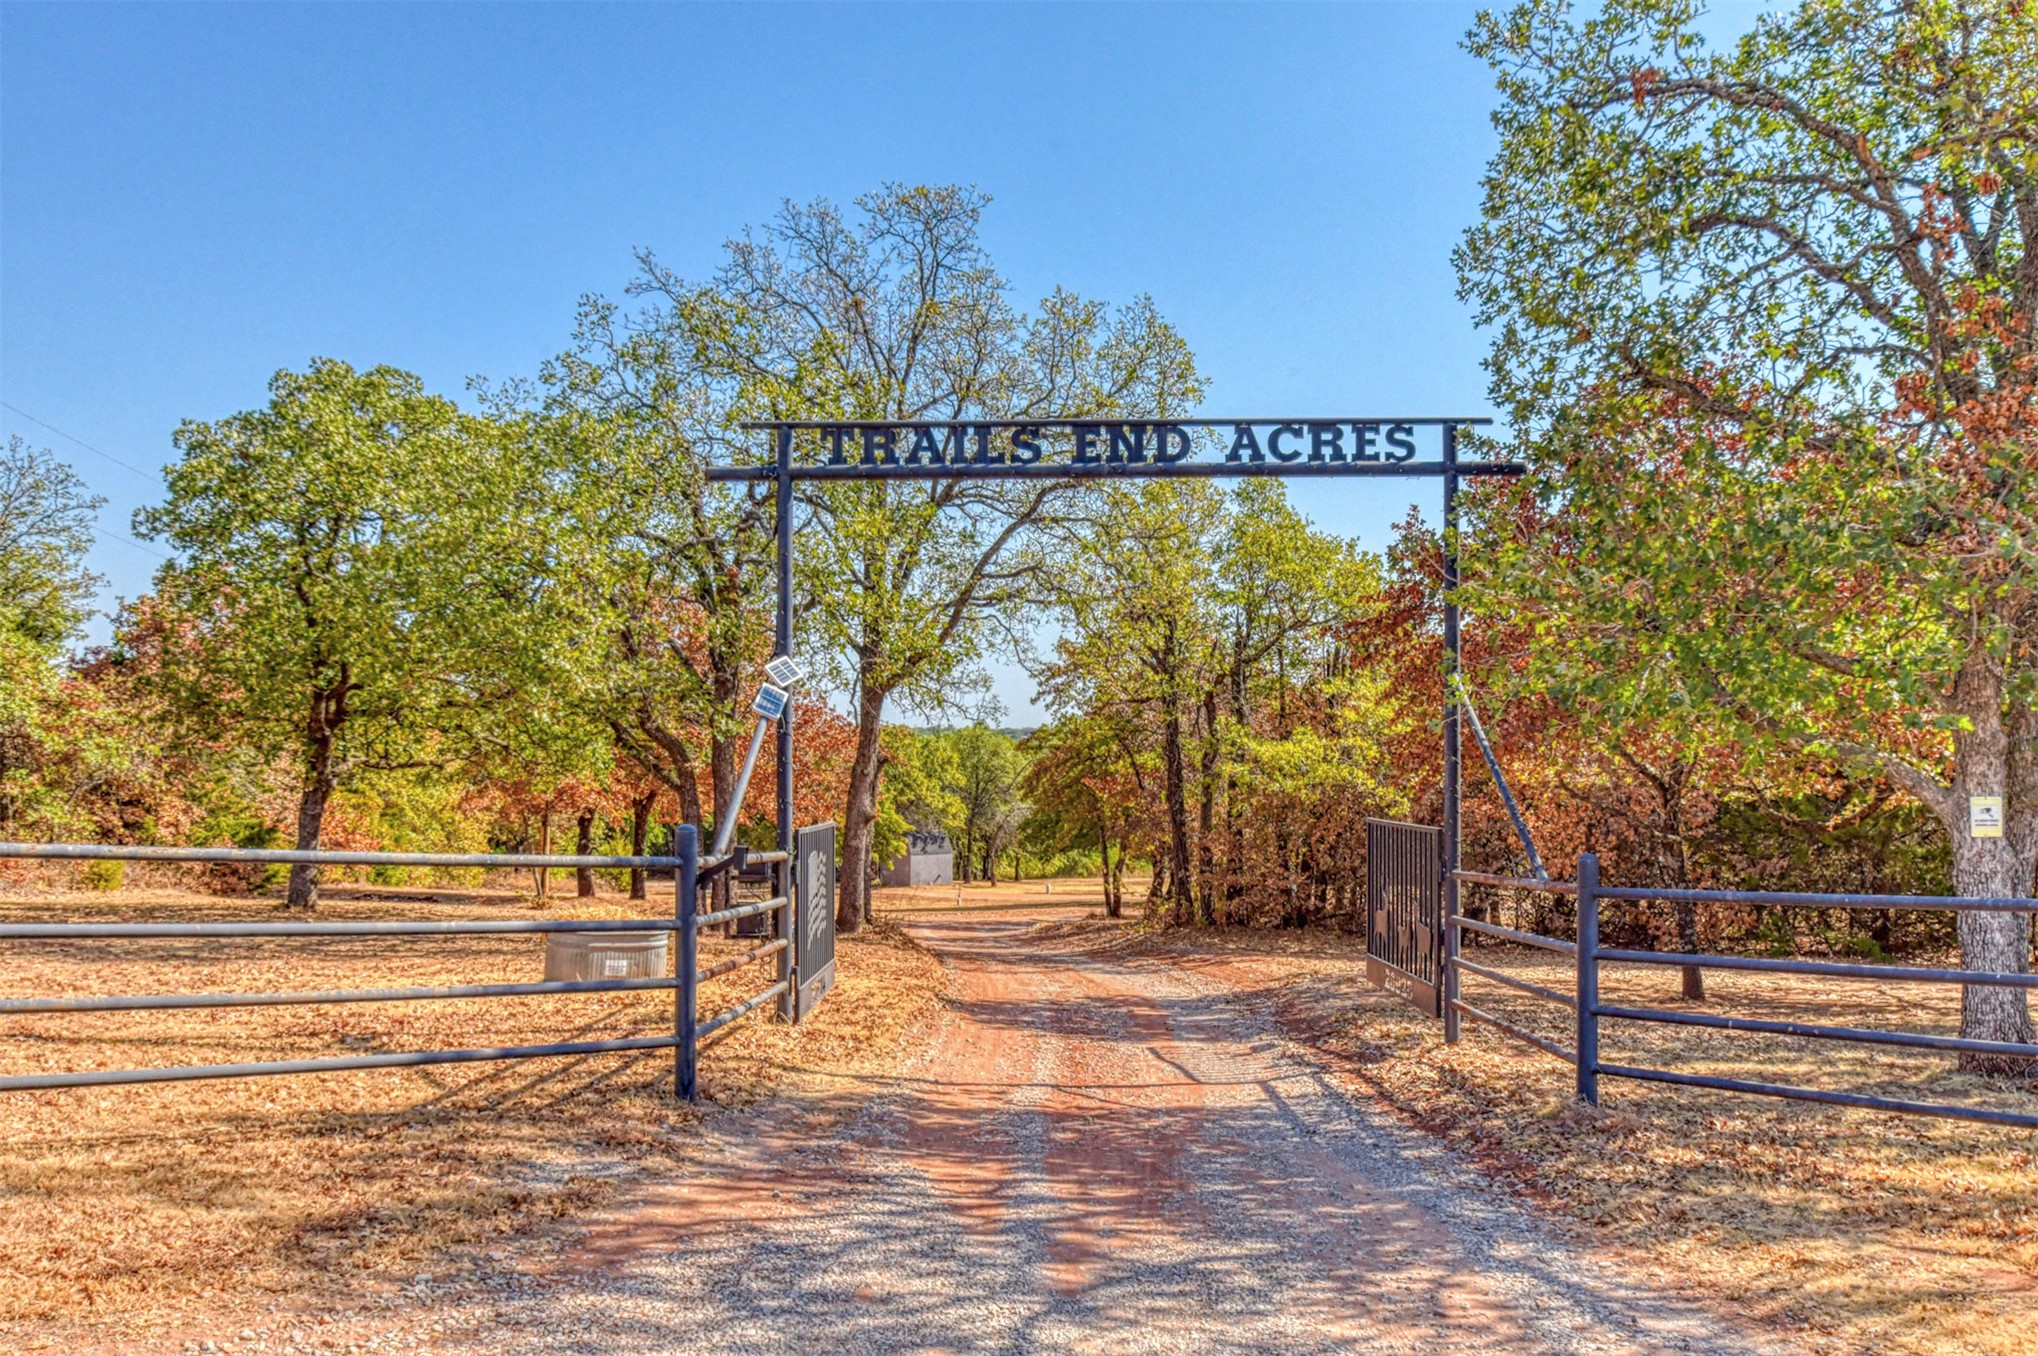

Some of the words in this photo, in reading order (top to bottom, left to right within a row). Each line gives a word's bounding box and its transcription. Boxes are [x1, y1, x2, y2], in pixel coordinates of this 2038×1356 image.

[821, 426, 1043, 464] TRAILS
[1072, 425, 1191, 463] END
[1225, 424, 1416, 462] ACRES
